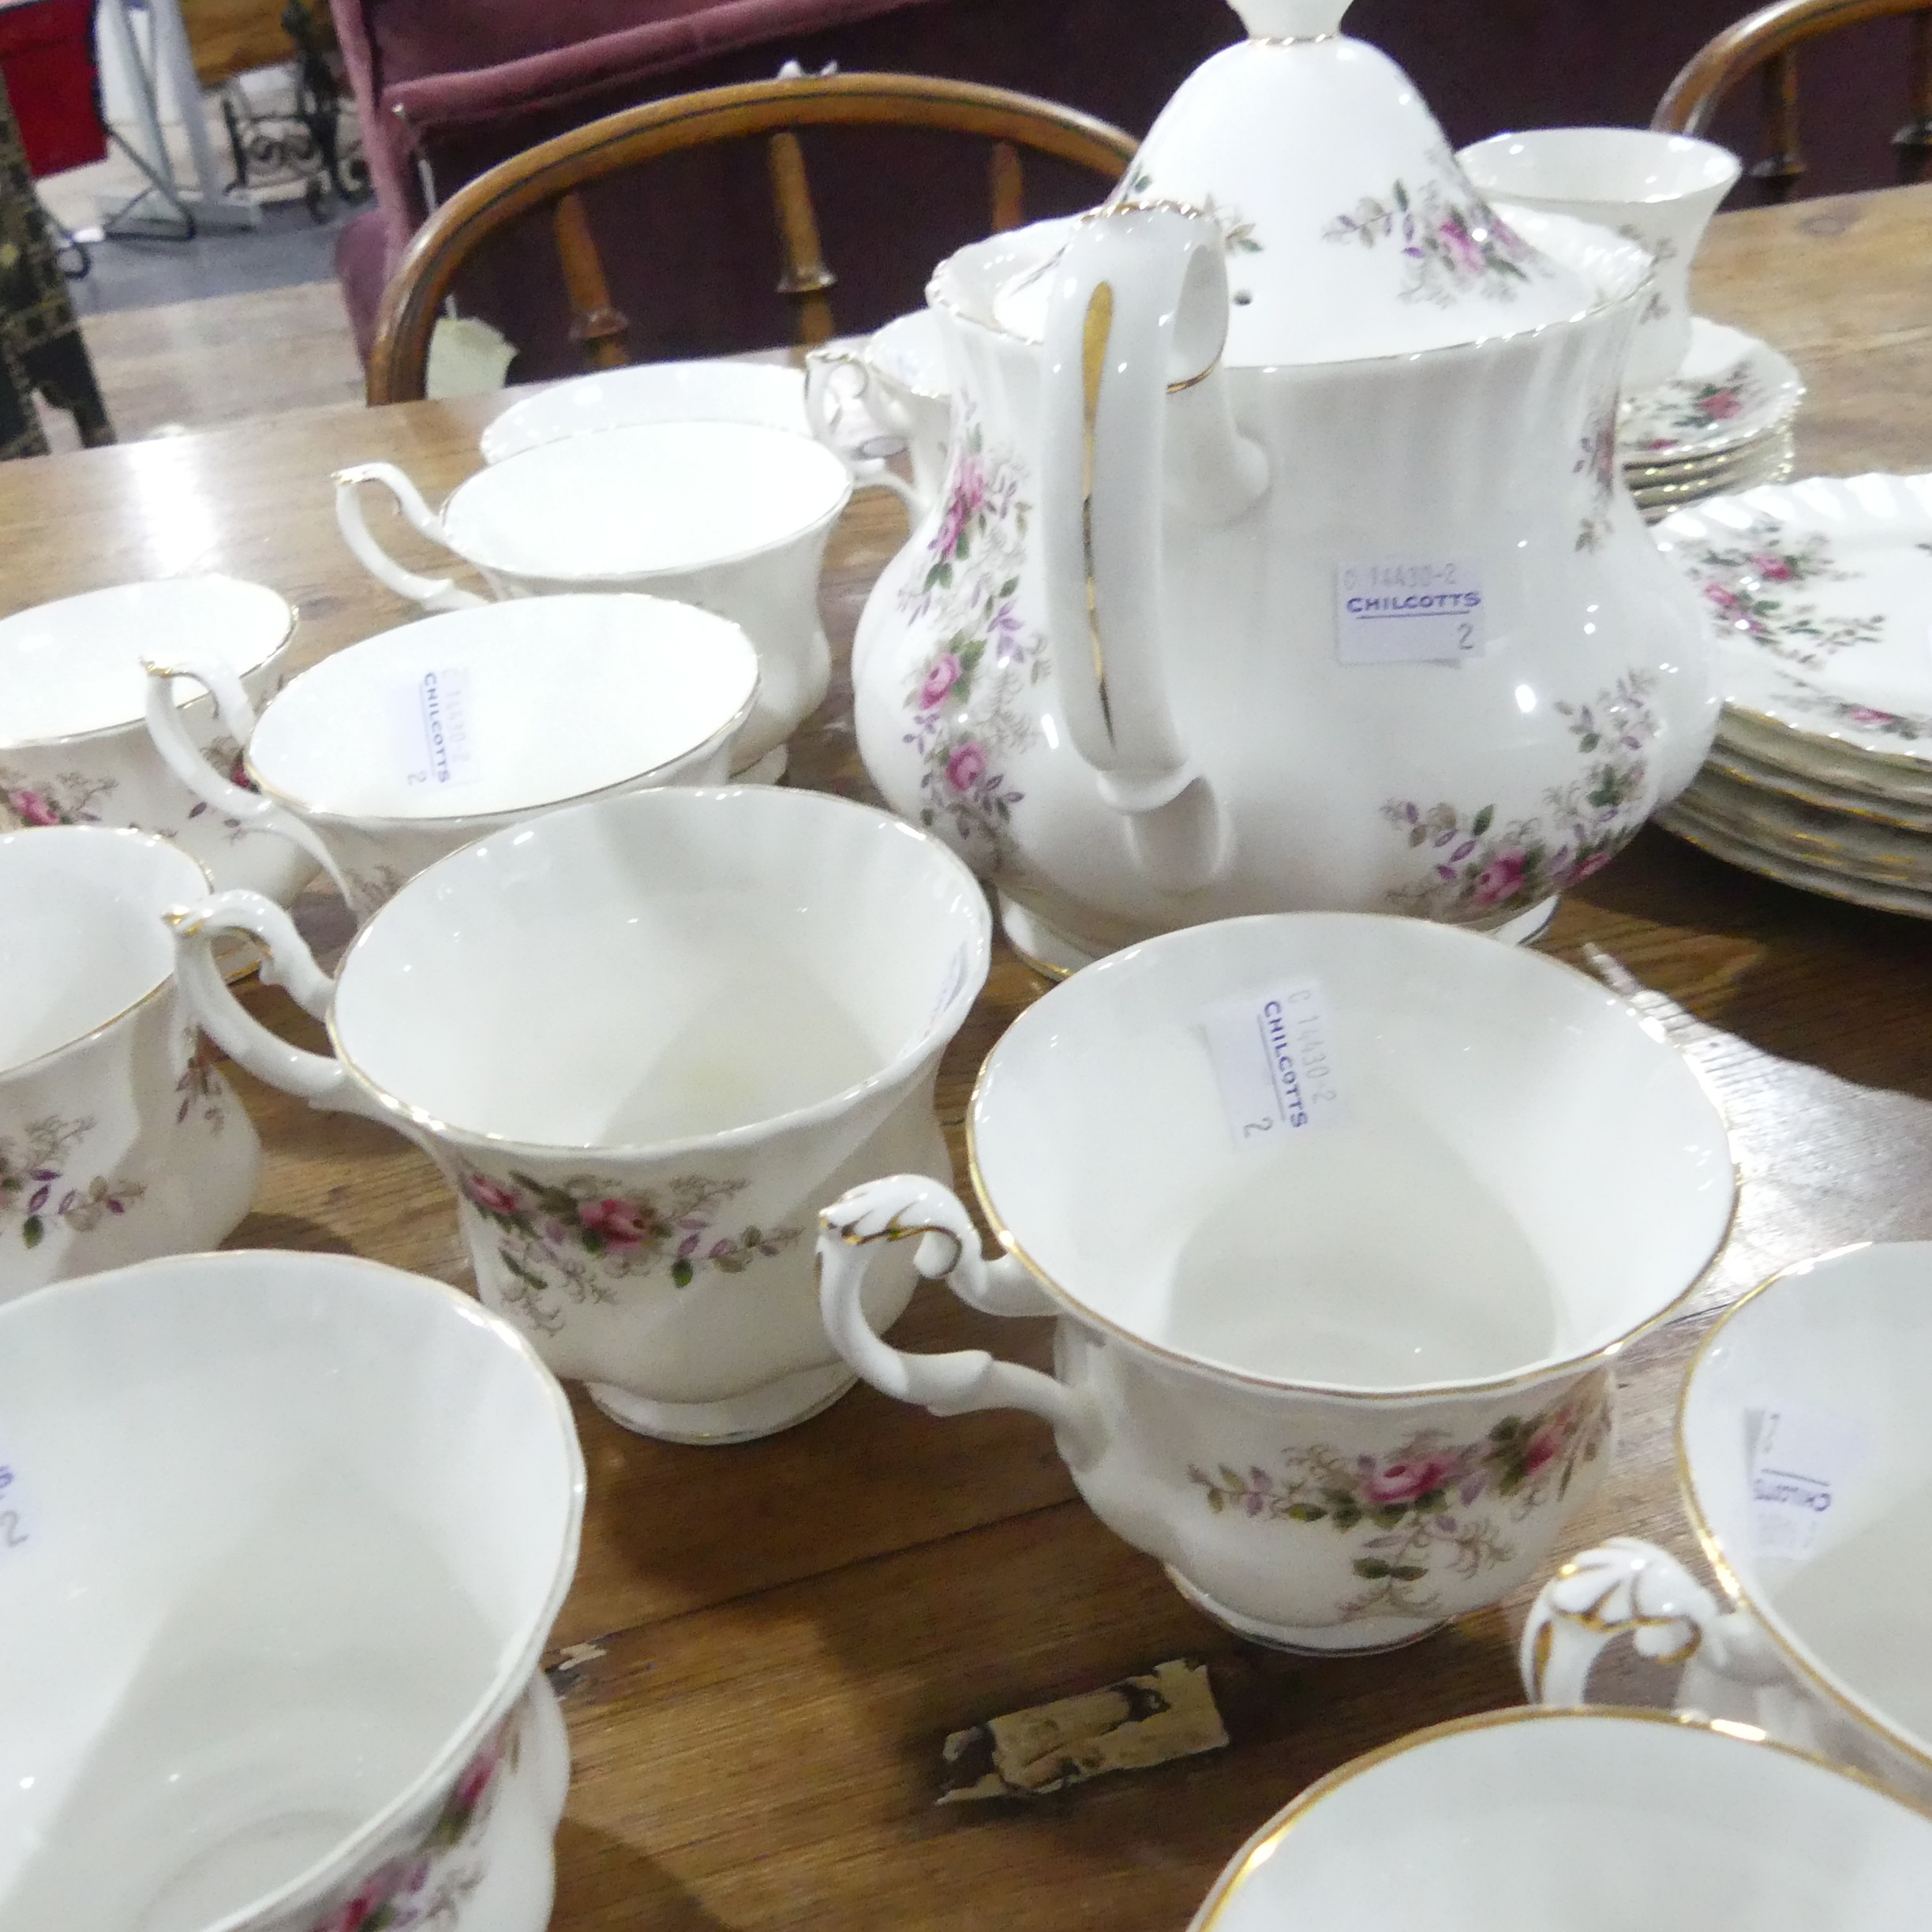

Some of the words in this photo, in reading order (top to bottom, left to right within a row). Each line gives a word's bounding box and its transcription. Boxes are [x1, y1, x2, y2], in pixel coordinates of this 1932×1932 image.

[1346, 591, 1481, 613] CHILCOTTS
[1458, 622, 1474, 650] 2
[424, 672, 451, 783] CHILCOTTS
[406, 769, 428, 786] 2
[1264, 1000, 1309, 1129] CHILCOTTS
[1296, 1015, 1338, 1105] 14430-2
[1243, 1116, 1274, 1138] 2
[0, 1508, 29, 1548] 2
